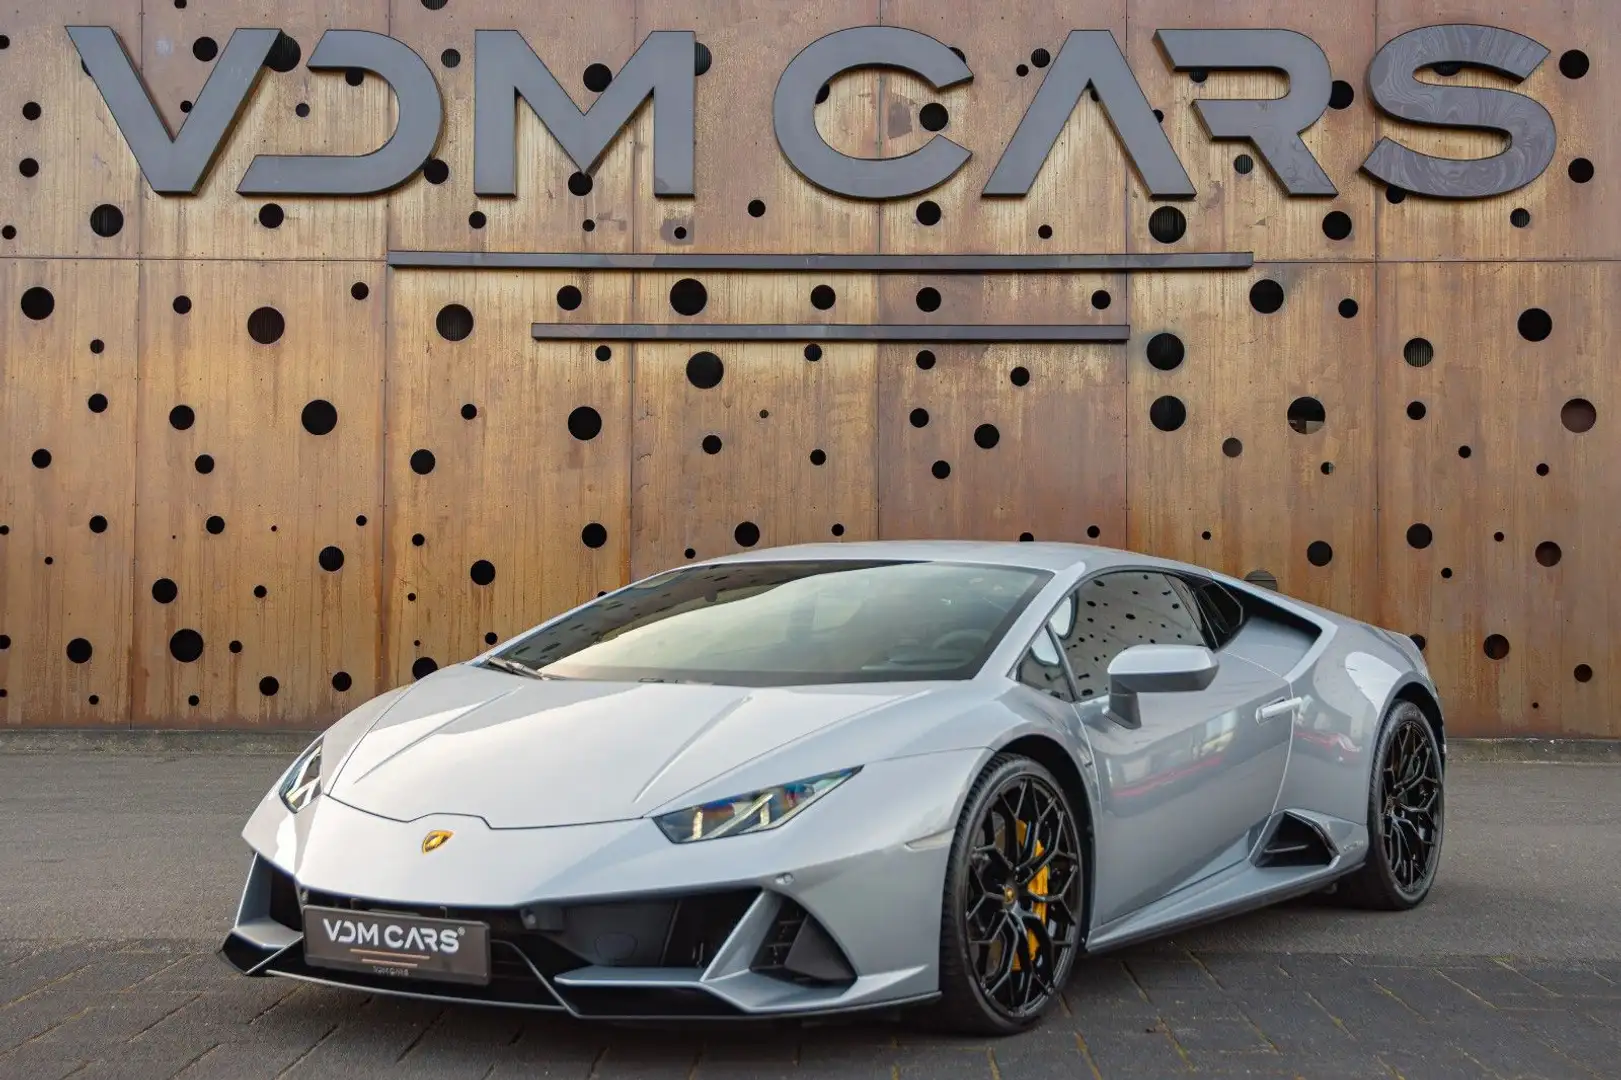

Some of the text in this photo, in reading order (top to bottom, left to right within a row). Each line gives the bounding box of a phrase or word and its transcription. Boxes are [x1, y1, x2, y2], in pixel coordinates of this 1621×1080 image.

[65, 24, 1558, 200] VDM CARS
[323, 918, 379, 946] VDM
